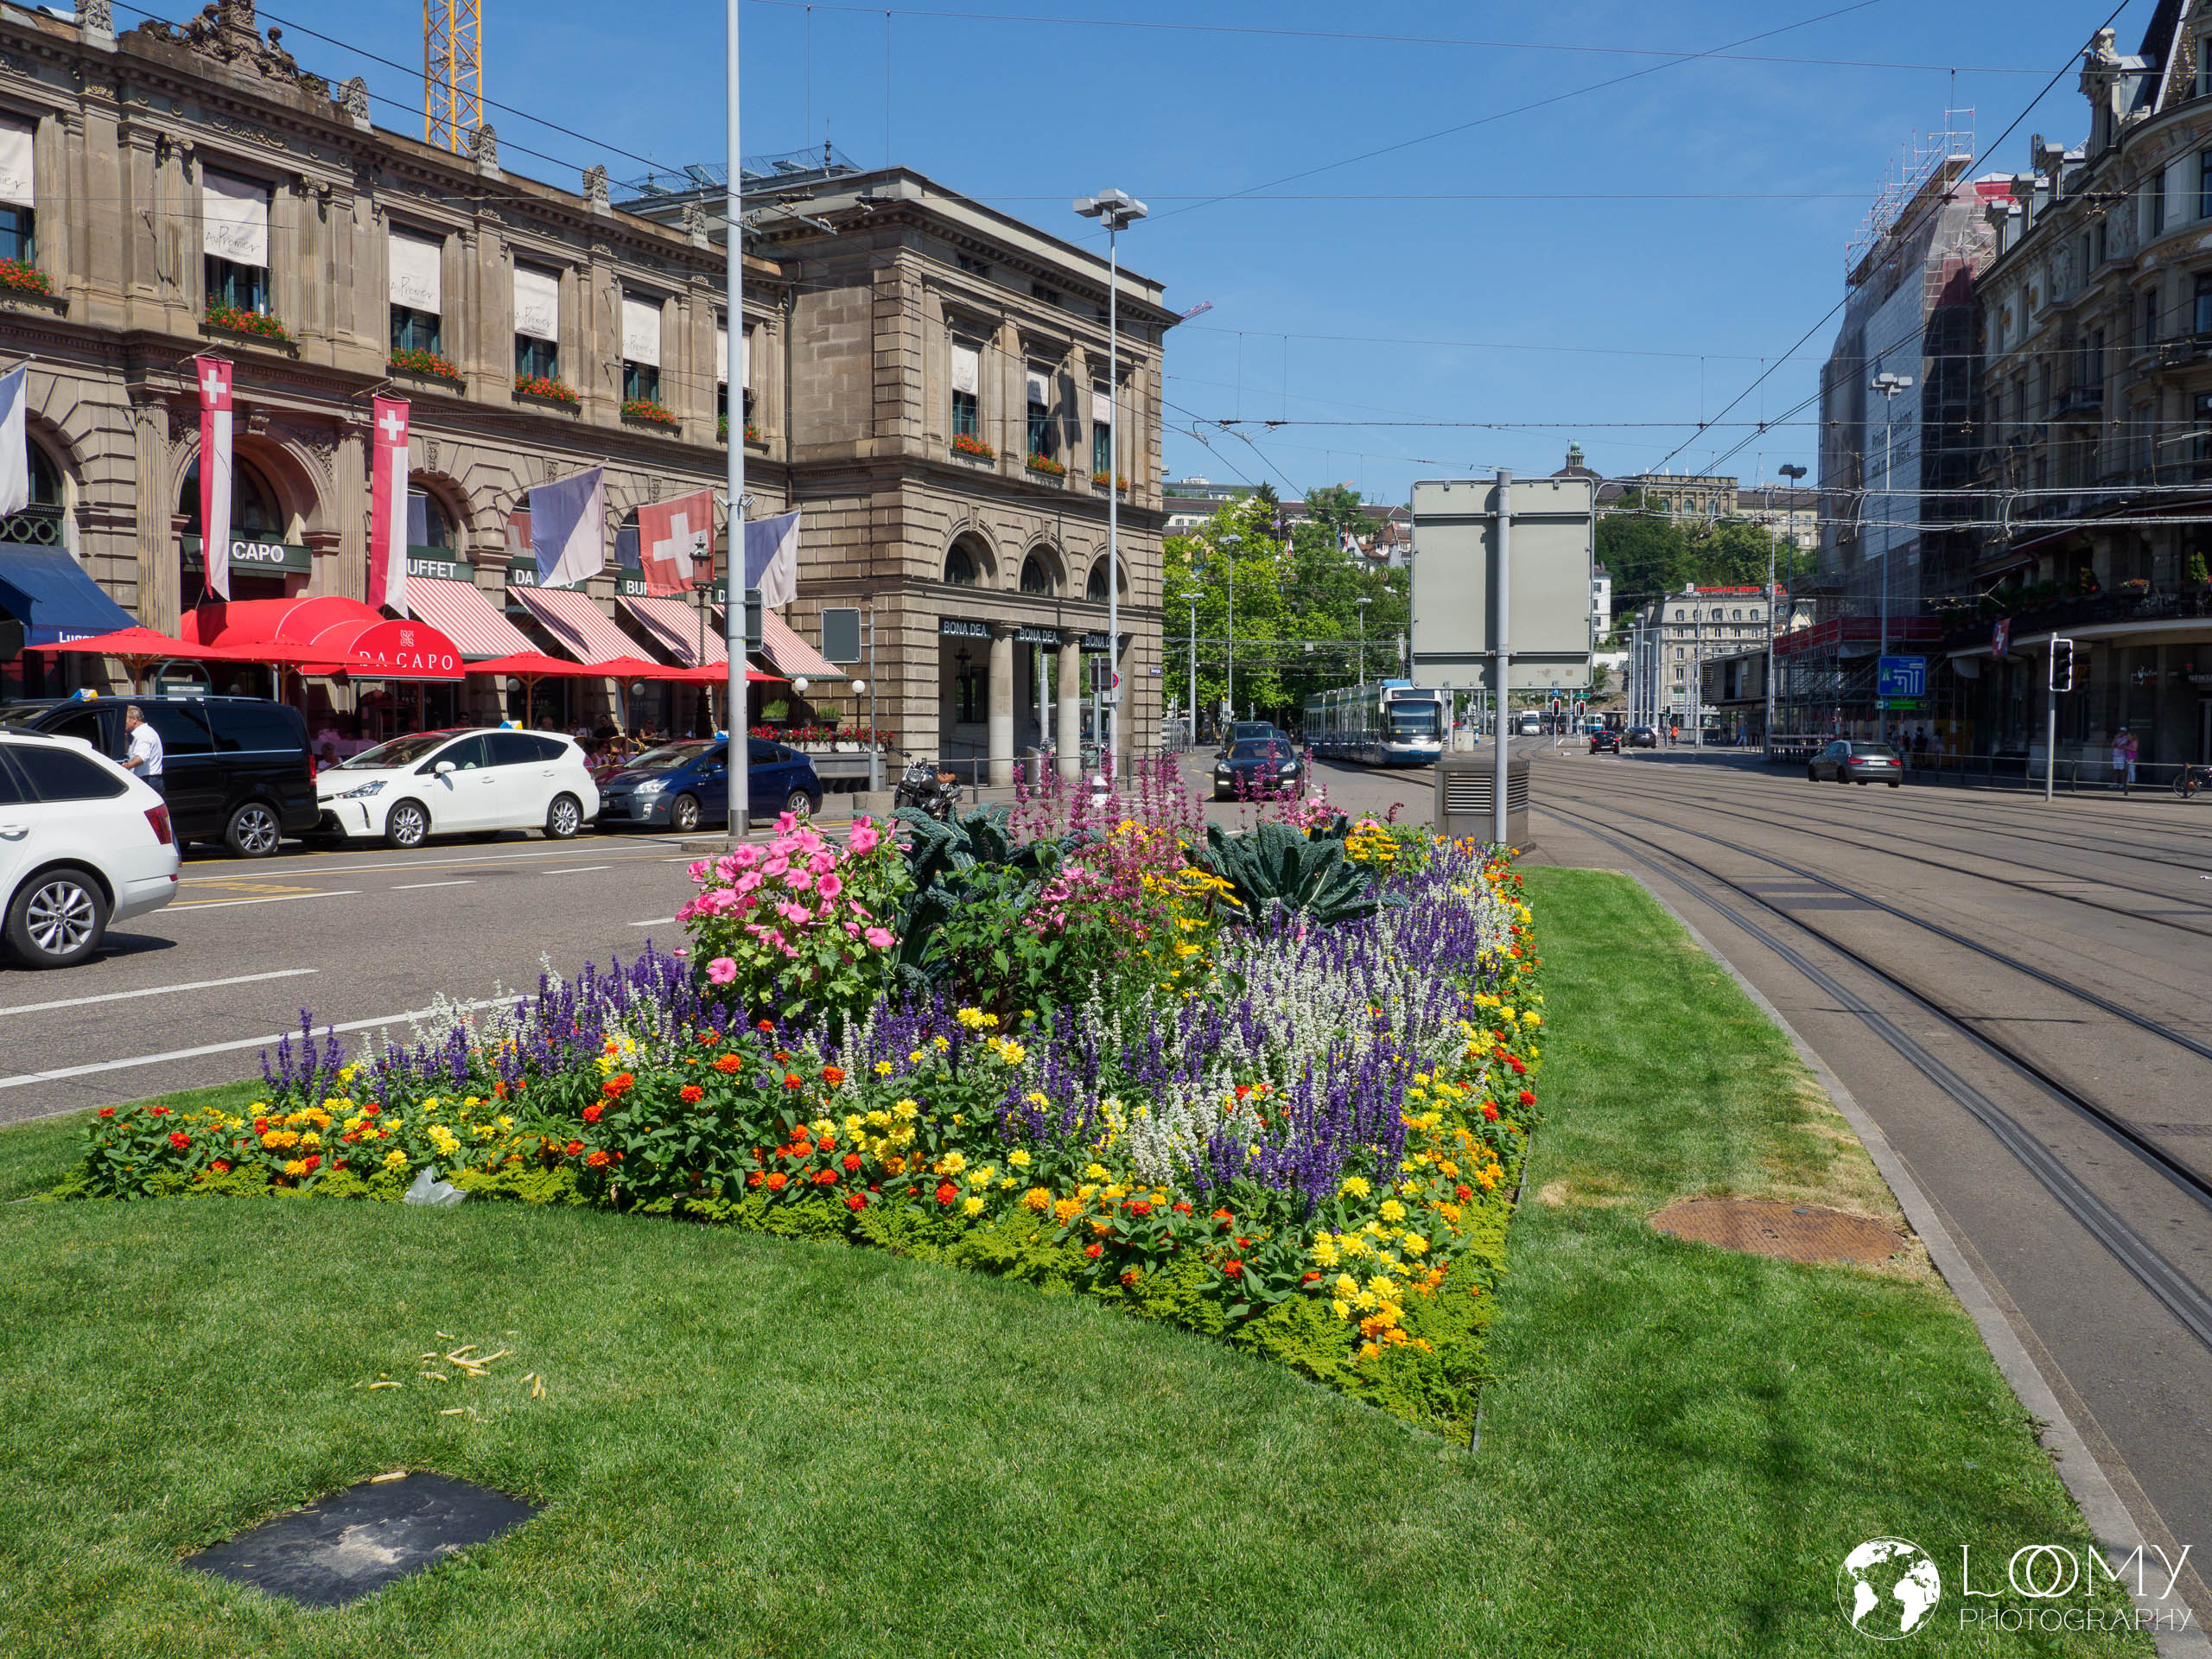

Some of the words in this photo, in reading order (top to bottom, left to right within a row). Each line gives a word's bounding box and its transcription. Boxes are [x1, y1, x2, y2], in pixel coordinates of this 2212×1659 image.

[232, 541, 284, 563] CAPO
[407, 558, 456, 578] UFFET
[516, 569, 534, 585] DA
[944, 620, 969, 635] BONA
[970, 623, 987, 636] DEA
[1020, 628, 1041, 640] BONA
[1042, 631, 1058, 642] DEA
[1085, 635, 1104, 647] BONA
[397, 652, 454, 670] CAPO
